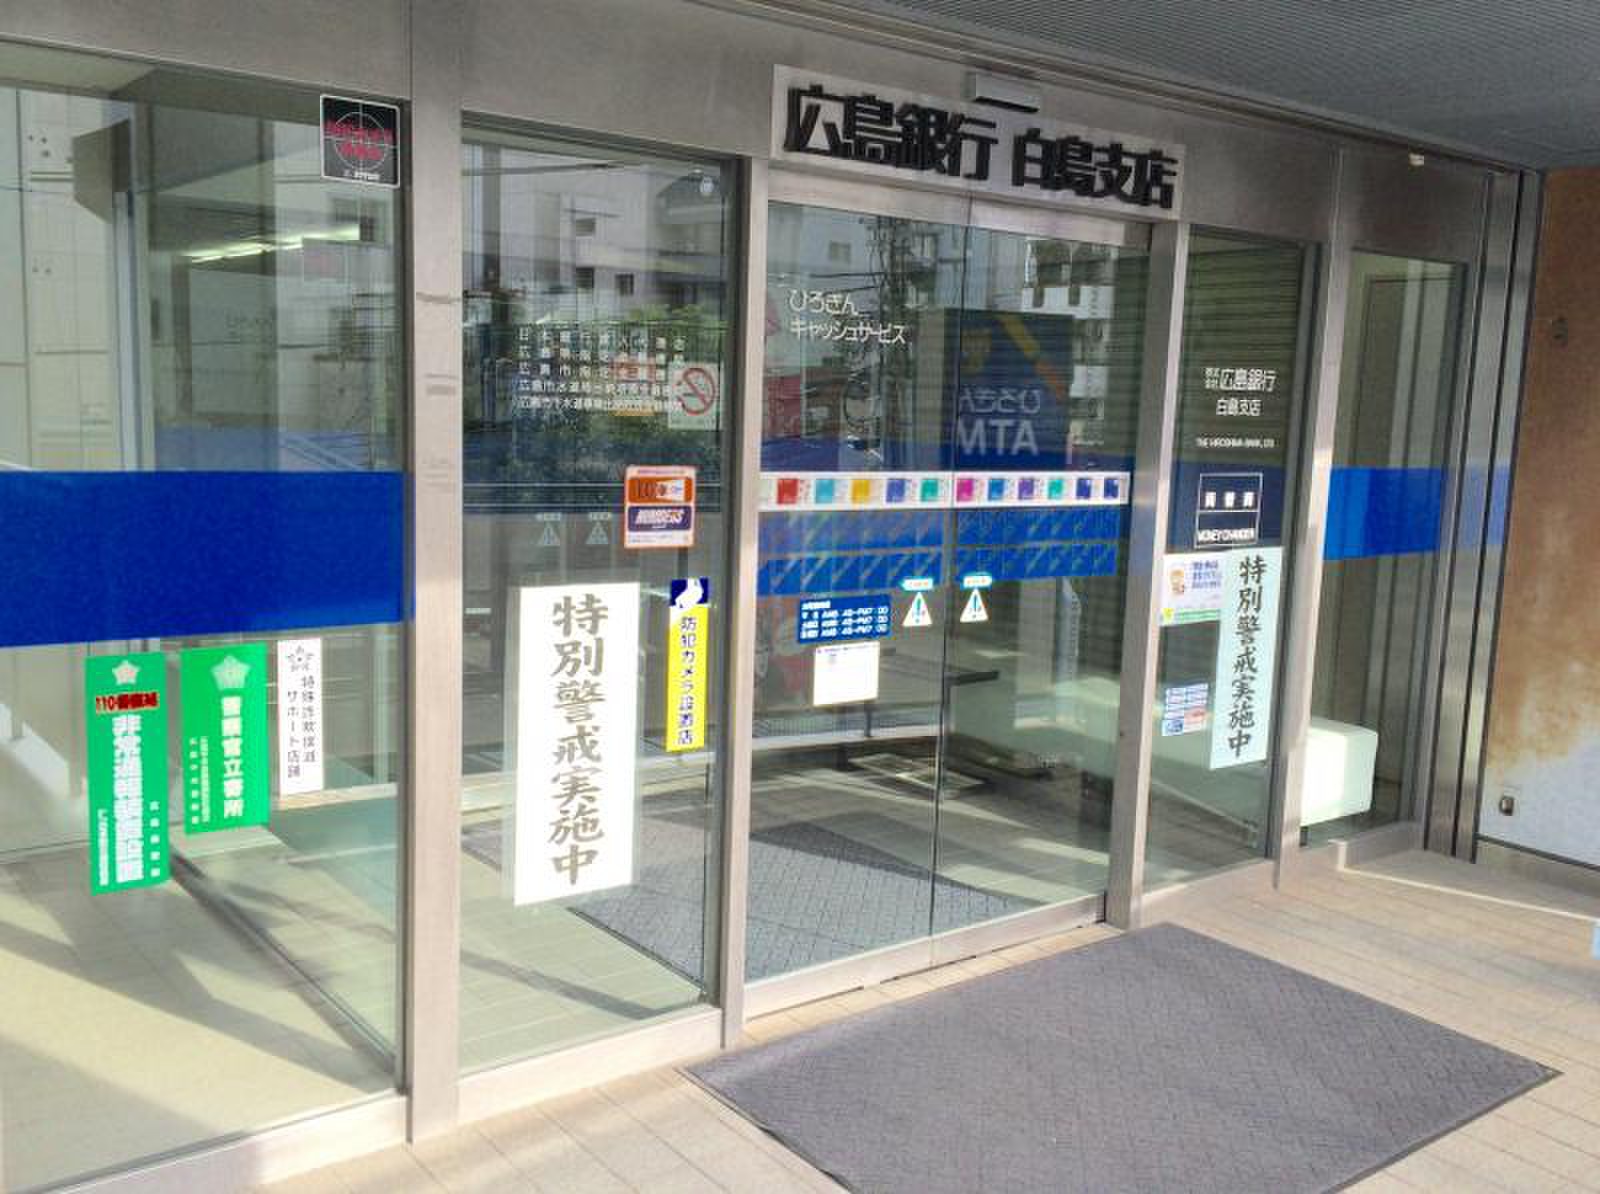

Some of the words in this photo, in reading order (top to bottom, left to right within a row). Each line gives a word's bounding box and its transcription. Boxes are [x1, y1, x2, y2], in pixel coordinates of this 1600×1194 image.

[784, 84, 999, 181] 広島銀行
[1011, 127, 1179, 209] 白島支店
[790, 318, 906, 344] キャッシュサービス
[1215, 397, 1262, 416] 白島支店
[1220, 368, 1276, 392] 広島銀行
[1228, 555, 1266, 757] 特別警戒実施中
[548, 593, 608, 885] 特別警戒実施中
